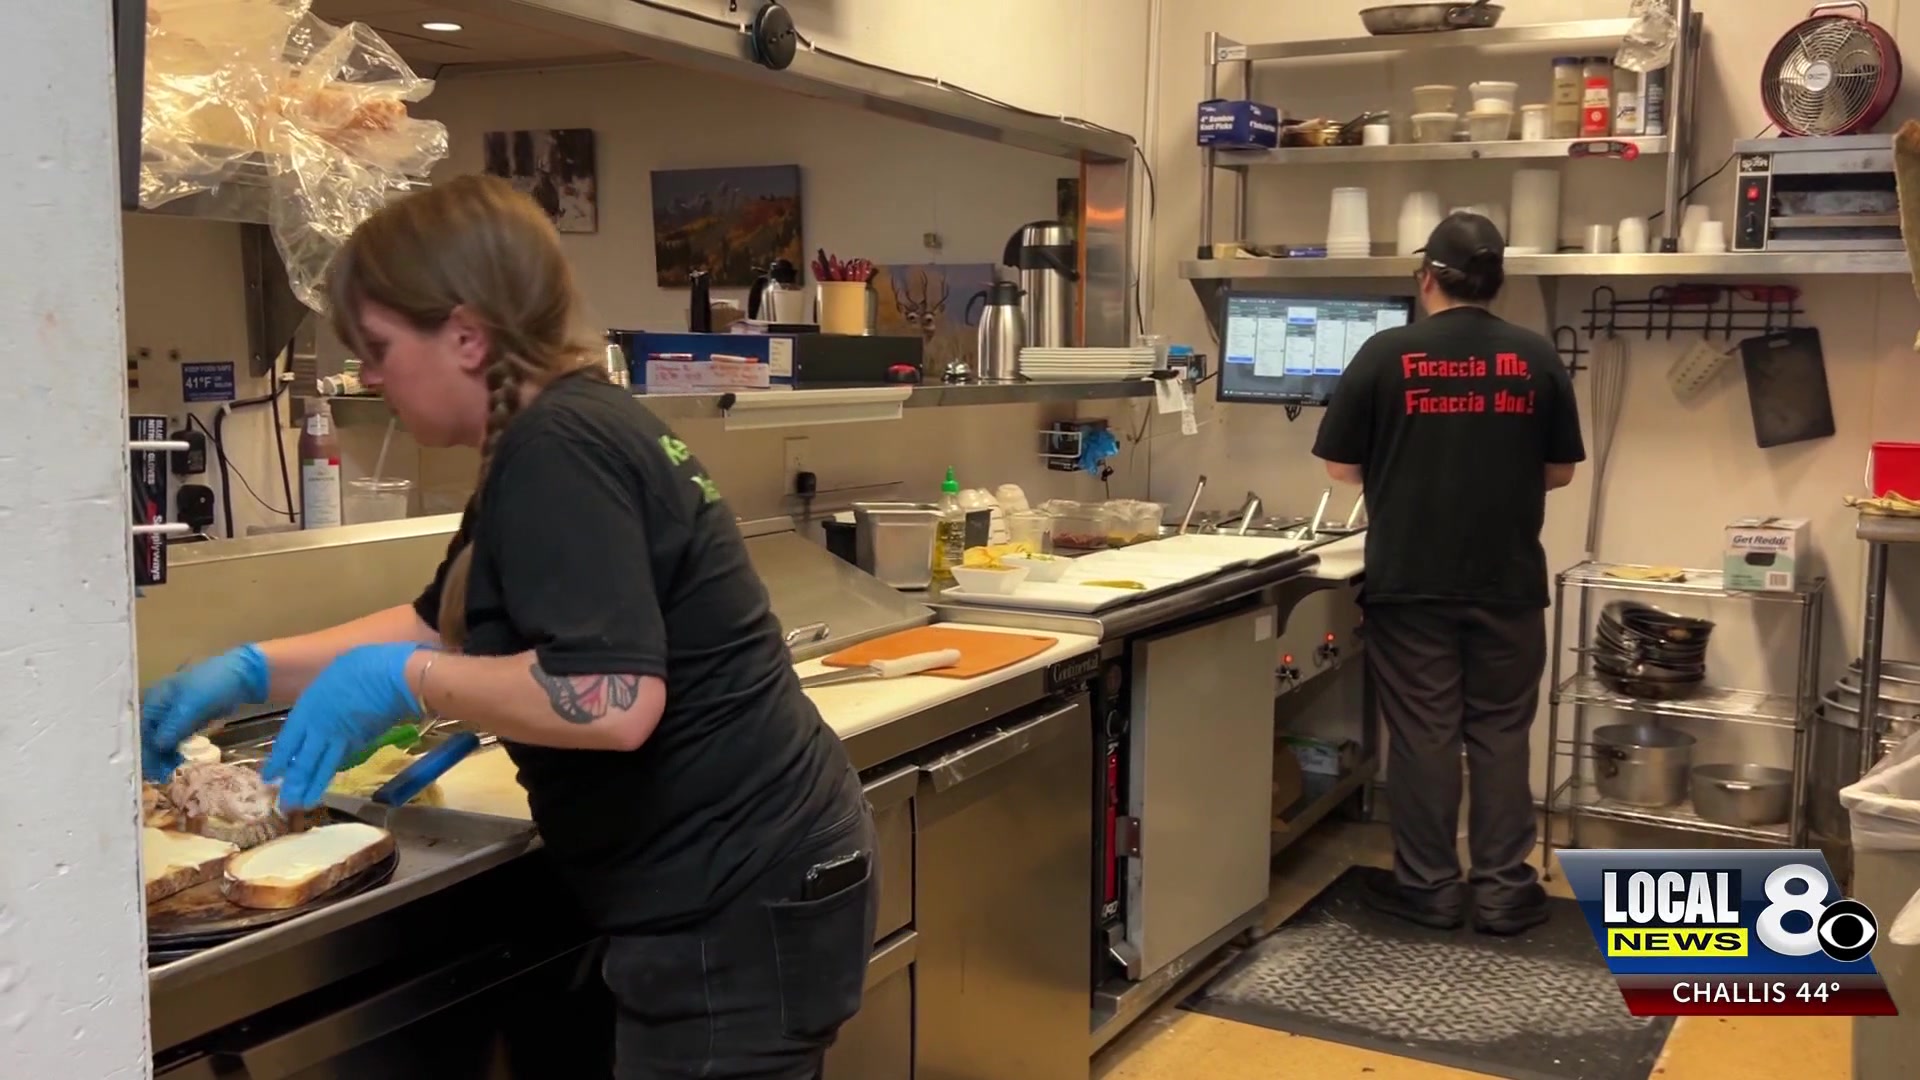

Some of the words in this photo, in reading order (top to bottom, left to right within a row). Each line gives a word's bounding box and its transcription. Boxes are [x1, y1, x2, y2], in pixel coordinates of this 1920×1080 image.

[1401, 352, 1486, 379] Focaccia
[1496, 352, 1532, 380] Me,
[185, 376, 212, 389] 41°F
[1405, 388, 1486, 415] Focaccia
[1494, 389, 1535, 415] You!
[147, 452, 156, 485] GLOVES
[1733, 534, 1753, 545] Get
